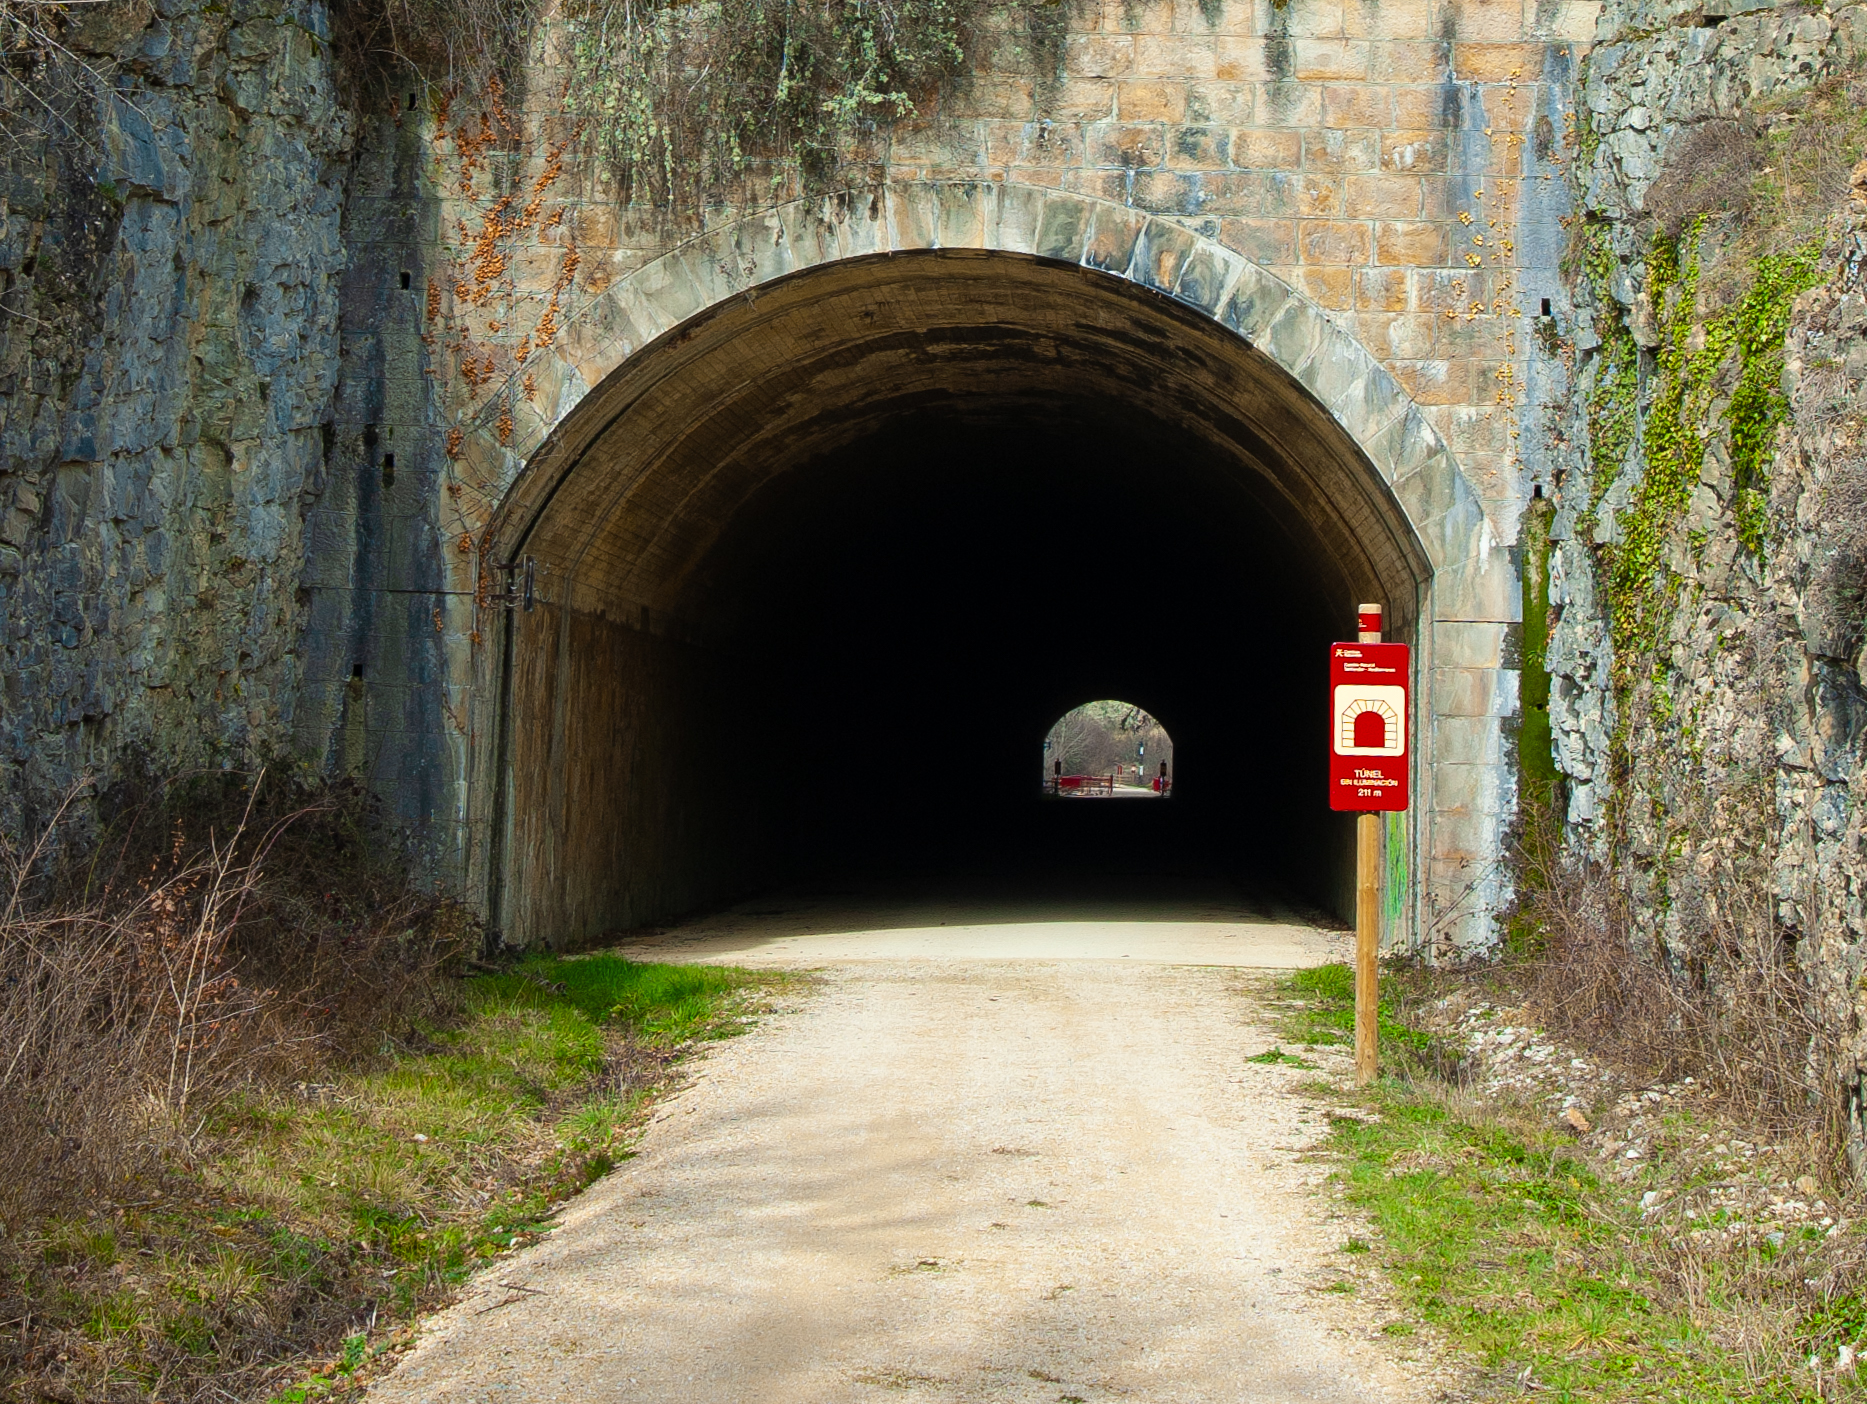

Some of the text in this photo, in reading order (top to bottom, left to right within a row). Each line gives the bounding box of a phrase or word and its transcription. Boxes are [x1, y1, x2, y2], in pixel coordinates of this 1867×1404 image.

[1354, 767, 1385, 779] TÚNEL
[1353, 778, 1399, 787] ILUMINACIÓN
[1357, 787, 1382, 797] 211 m
